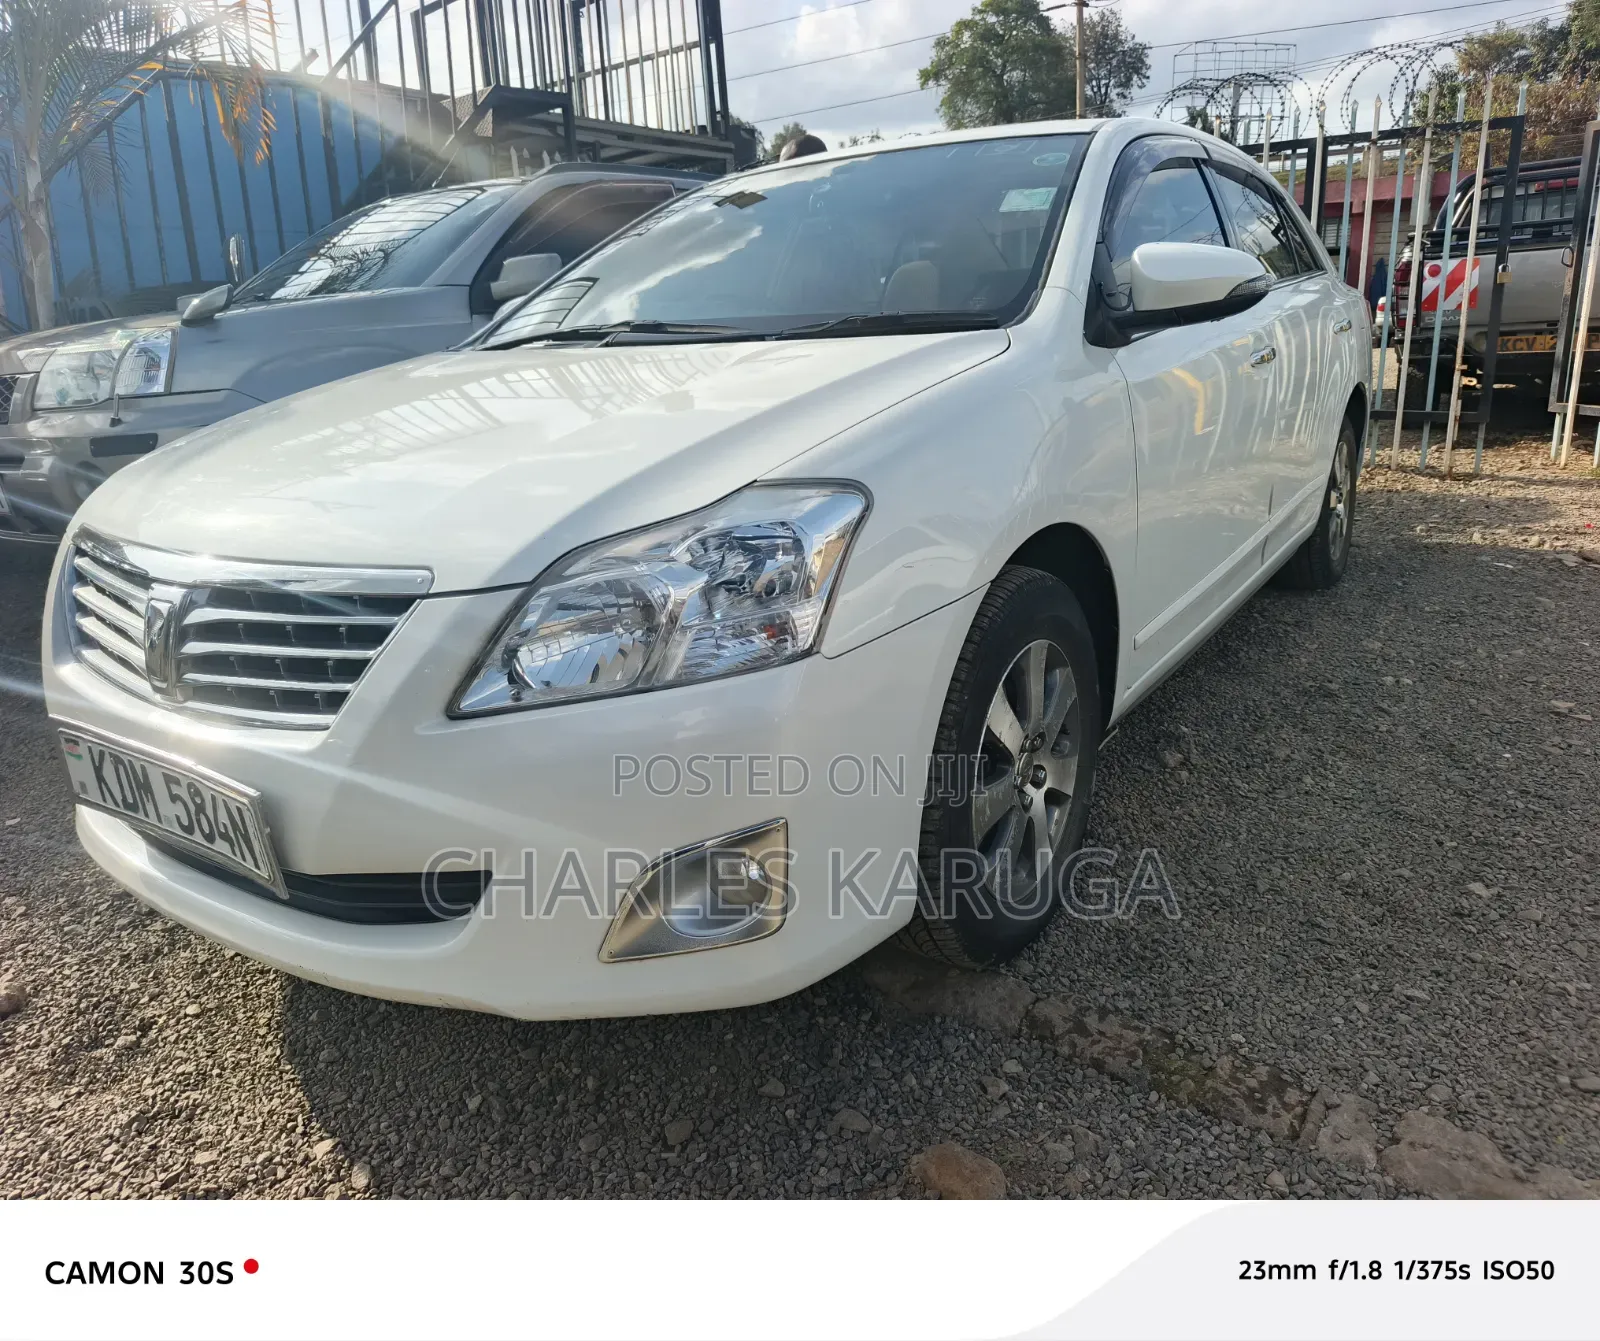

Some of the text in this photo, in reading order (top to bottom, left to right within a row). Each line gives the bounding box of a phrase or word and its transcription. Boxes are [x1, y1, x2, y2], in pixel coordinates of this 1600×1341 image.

[1499, 337, 1537, 351] KCV
[87, 744, 262, 871] KDM 584N
